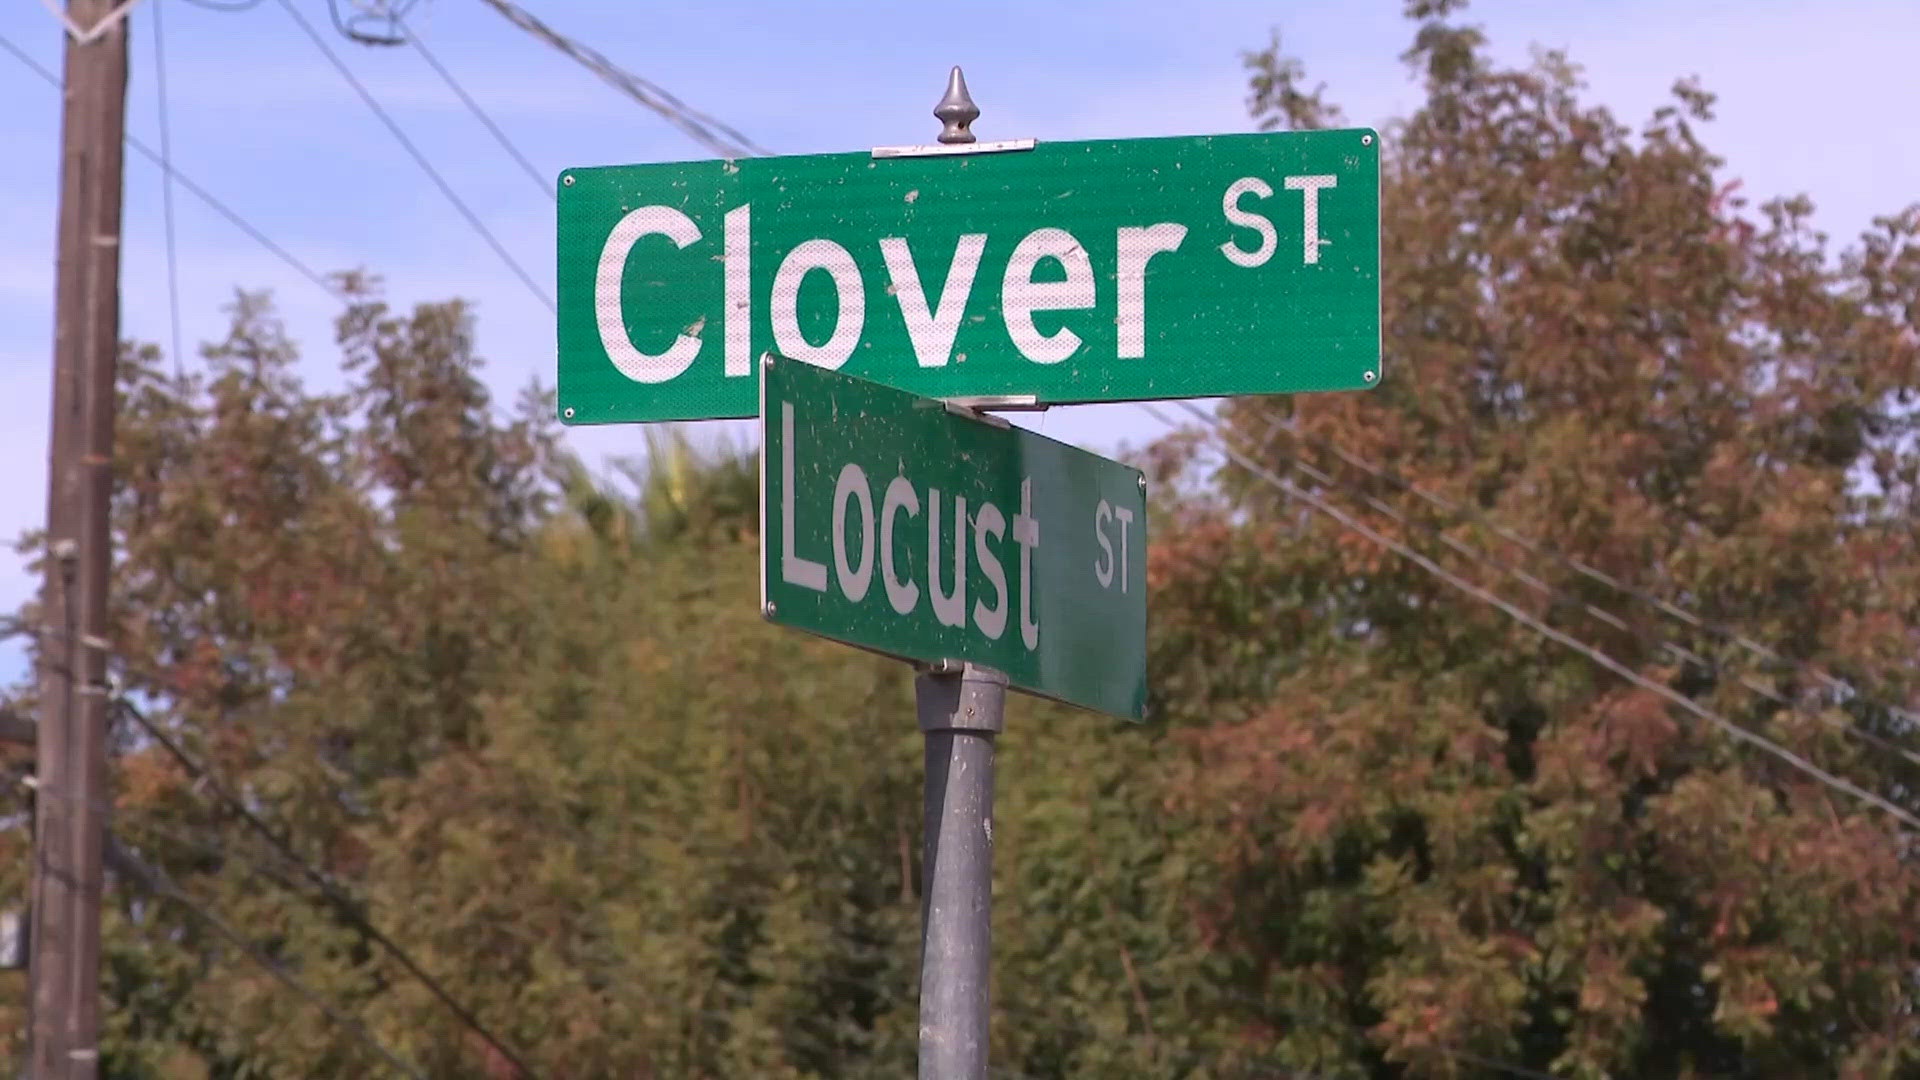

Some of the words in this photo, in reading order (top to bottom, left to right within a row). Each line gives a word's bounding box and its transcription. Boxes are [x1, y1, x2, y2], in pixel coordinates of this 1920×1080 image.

[595, 203, 1188, 383] Clover
[1220, 175, 1337, 267] ST
[782, 401, 1039, 650] Locust
[1095, 500, 1133, 594] ST
